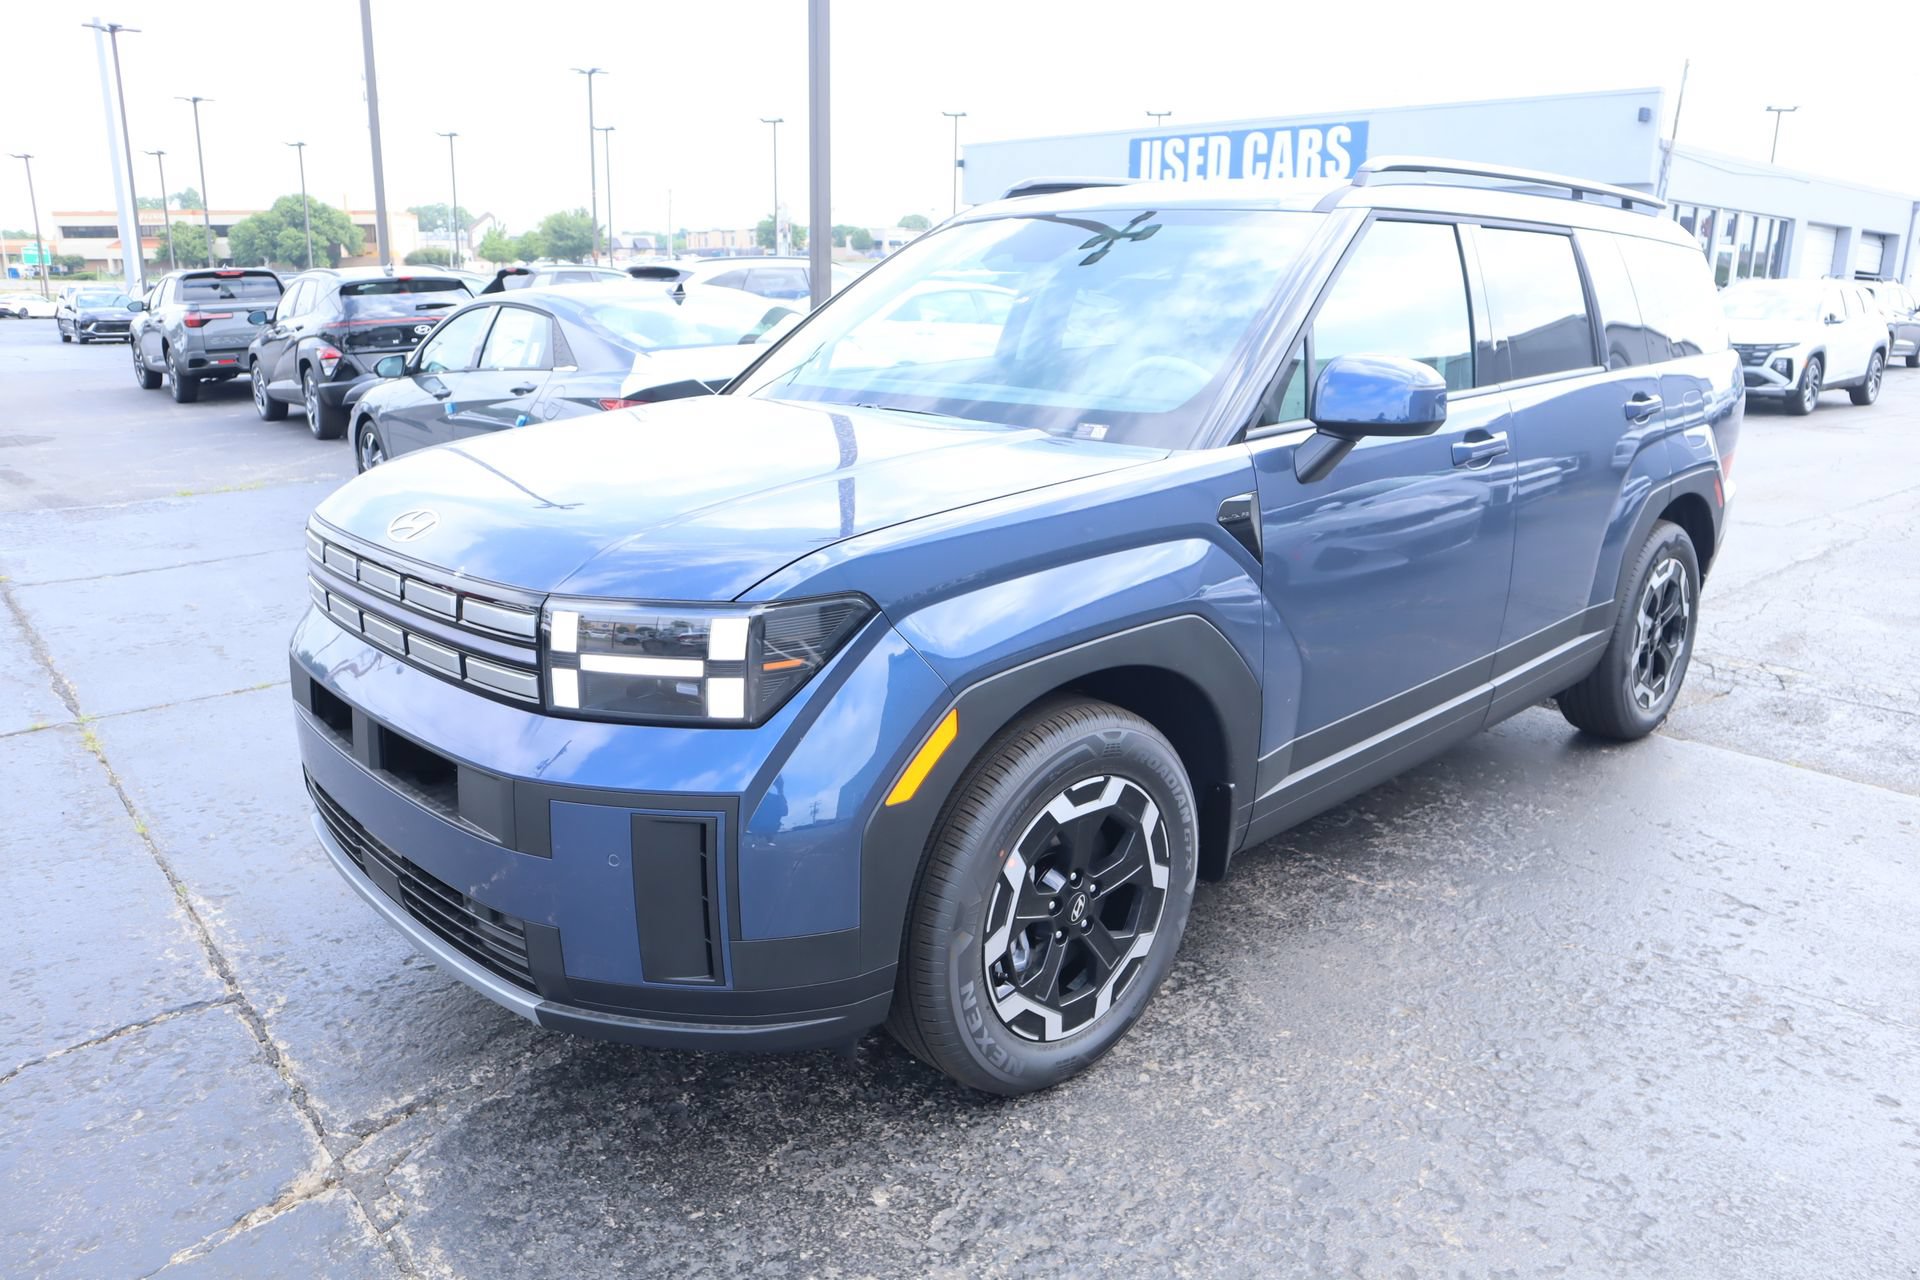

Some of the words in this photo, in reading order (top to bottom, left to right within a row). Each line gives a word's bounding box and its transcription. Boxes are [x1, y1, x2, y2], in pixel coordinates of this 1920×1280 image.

[1140, 134, 1231, 182] USED
[1242, 124, 1352, 180] CARS
[1135, 748, 1191, 823] ROADIAN
[1183, 827, 1193, 872] GTX
[960, 980, 1026, 1077] NEXEN
